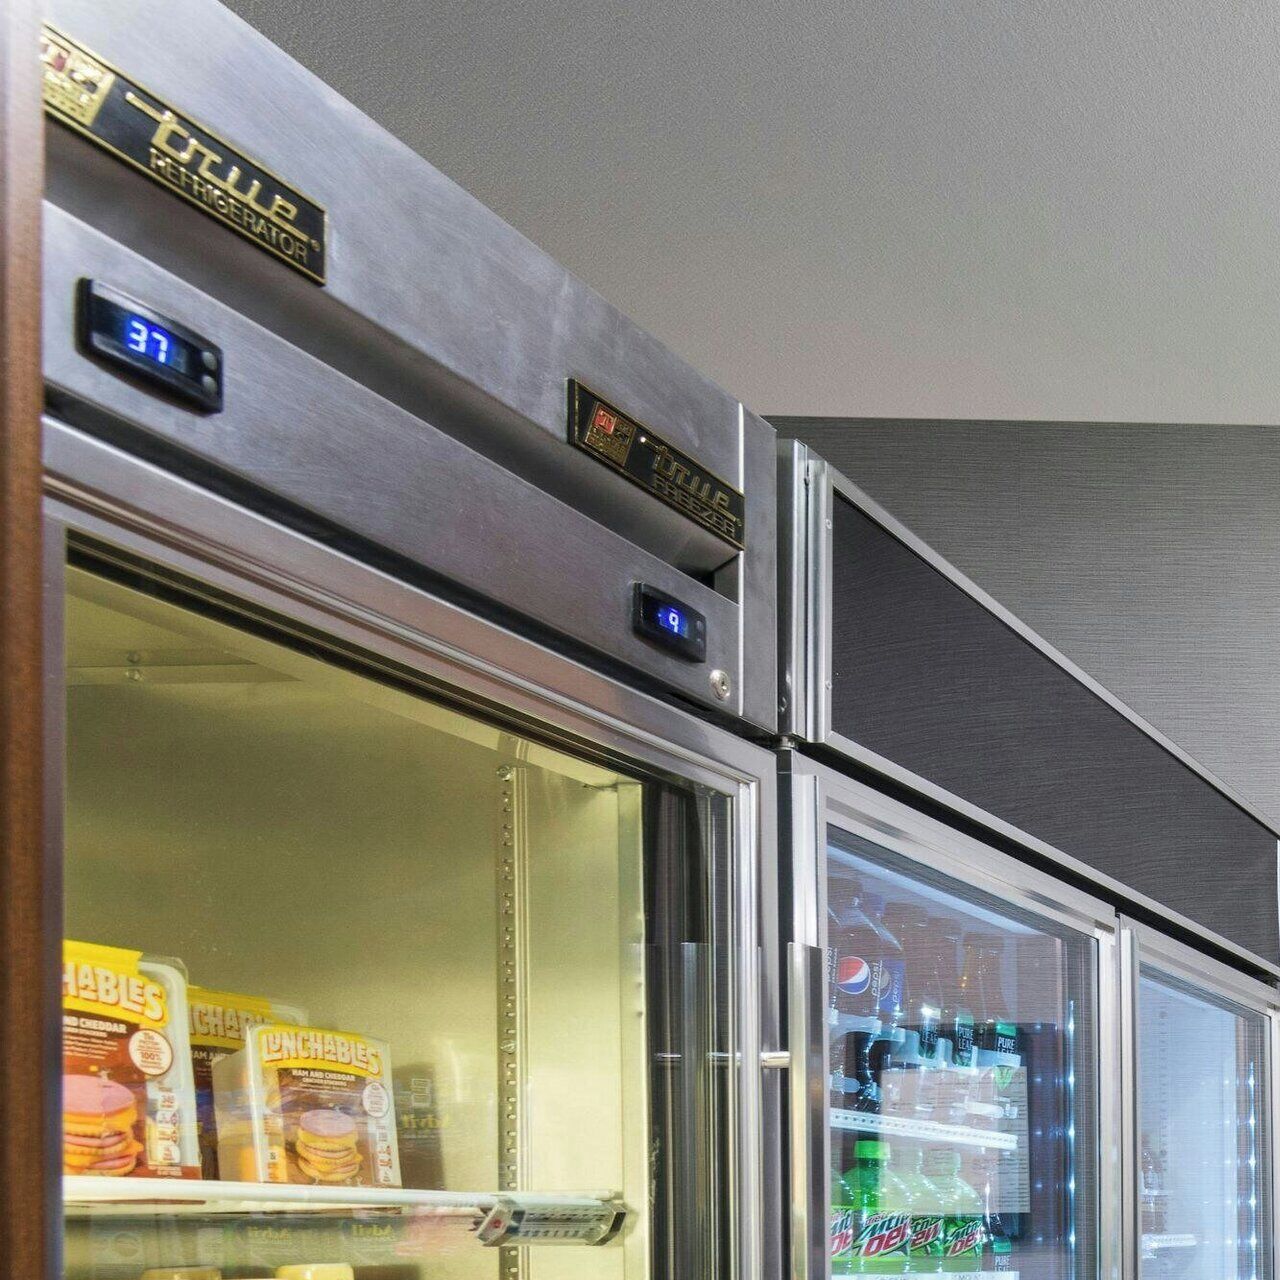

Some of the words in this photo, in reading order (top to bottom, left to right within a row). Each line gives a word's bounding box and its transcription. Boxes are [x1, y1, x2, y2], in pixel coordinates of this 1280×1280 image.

[149, 147, 309, 264] REFRIGERATOR
[125, 319, 169, 364] 37
[653, 474, 736, 540] FREEZER
[79, 1017, 128, 1034] CHEDDAR
[958, 1027, 974, 1039] PURE
[958, 1038, 974, 1049] LEAF
[997, 1037, 1015, 1048] PURE
[262, 1030, 382, 1076] LUNCHABLES
[324, 1072, 355, 1082] CHEDDAR
